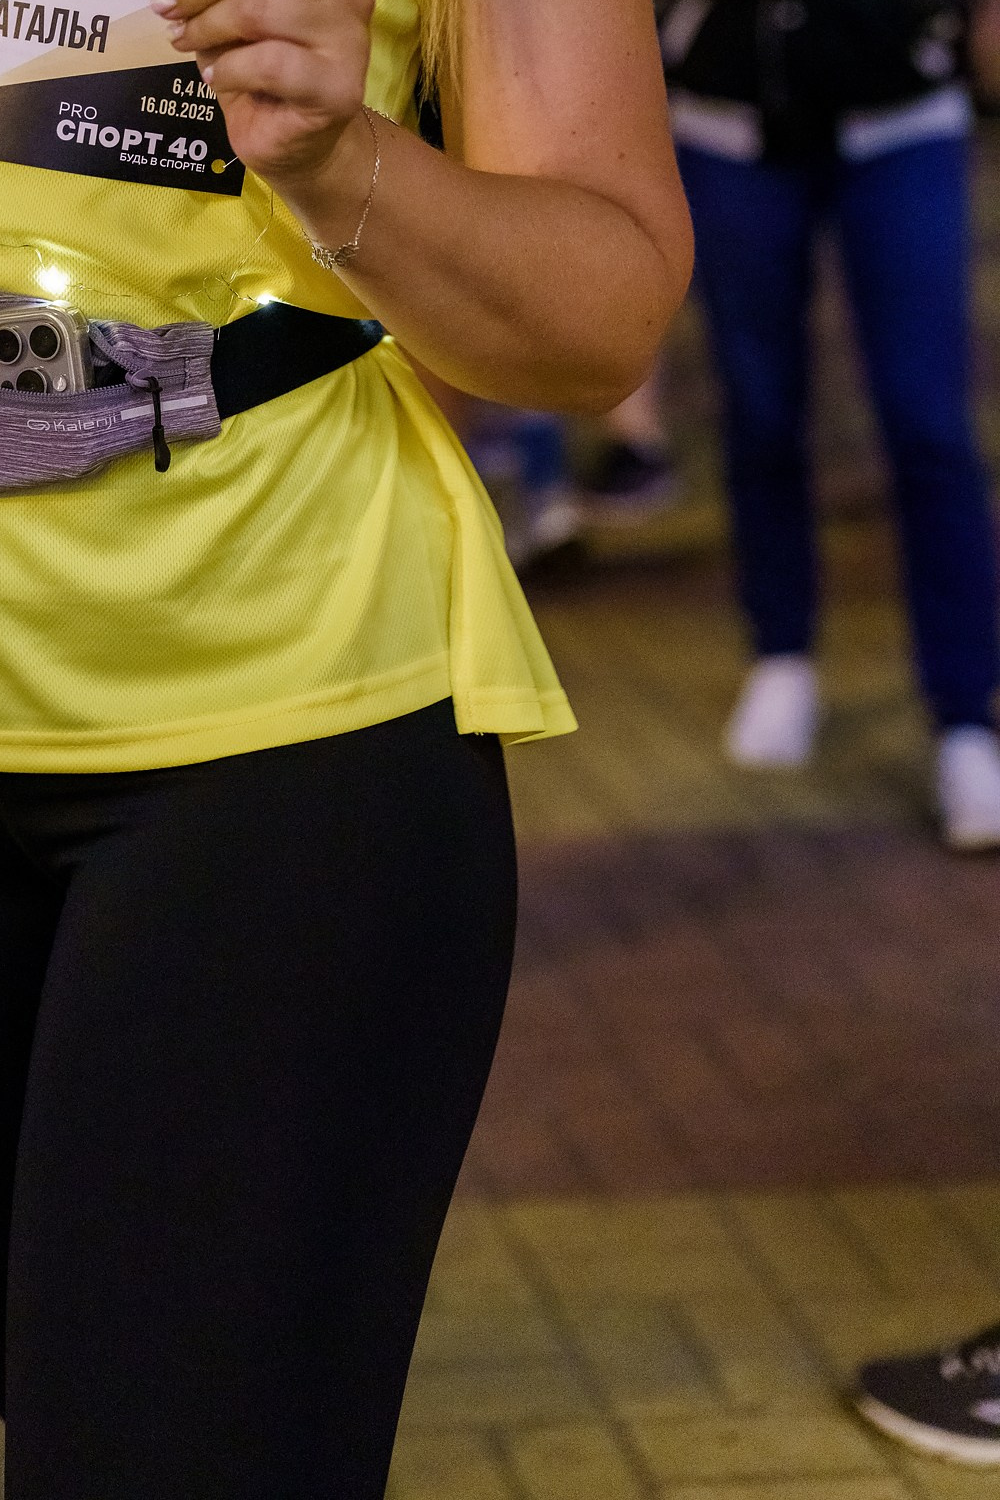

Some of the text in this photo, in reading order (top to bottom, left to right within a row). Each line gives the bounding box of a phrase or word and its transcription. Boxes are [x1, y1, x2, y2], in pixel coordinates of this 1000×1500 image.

[172, 78, 195, 98] 6,4
[58, 101, 98, 120] PRO
[140, 96, 215, 122] 16.08.2025
[56, 119, 209, 162] СПОРТ 40
[119, 152, 206, 173] БУДЬ В СПОРТЕ!
[53, 413, 117, 431] Kalenji
